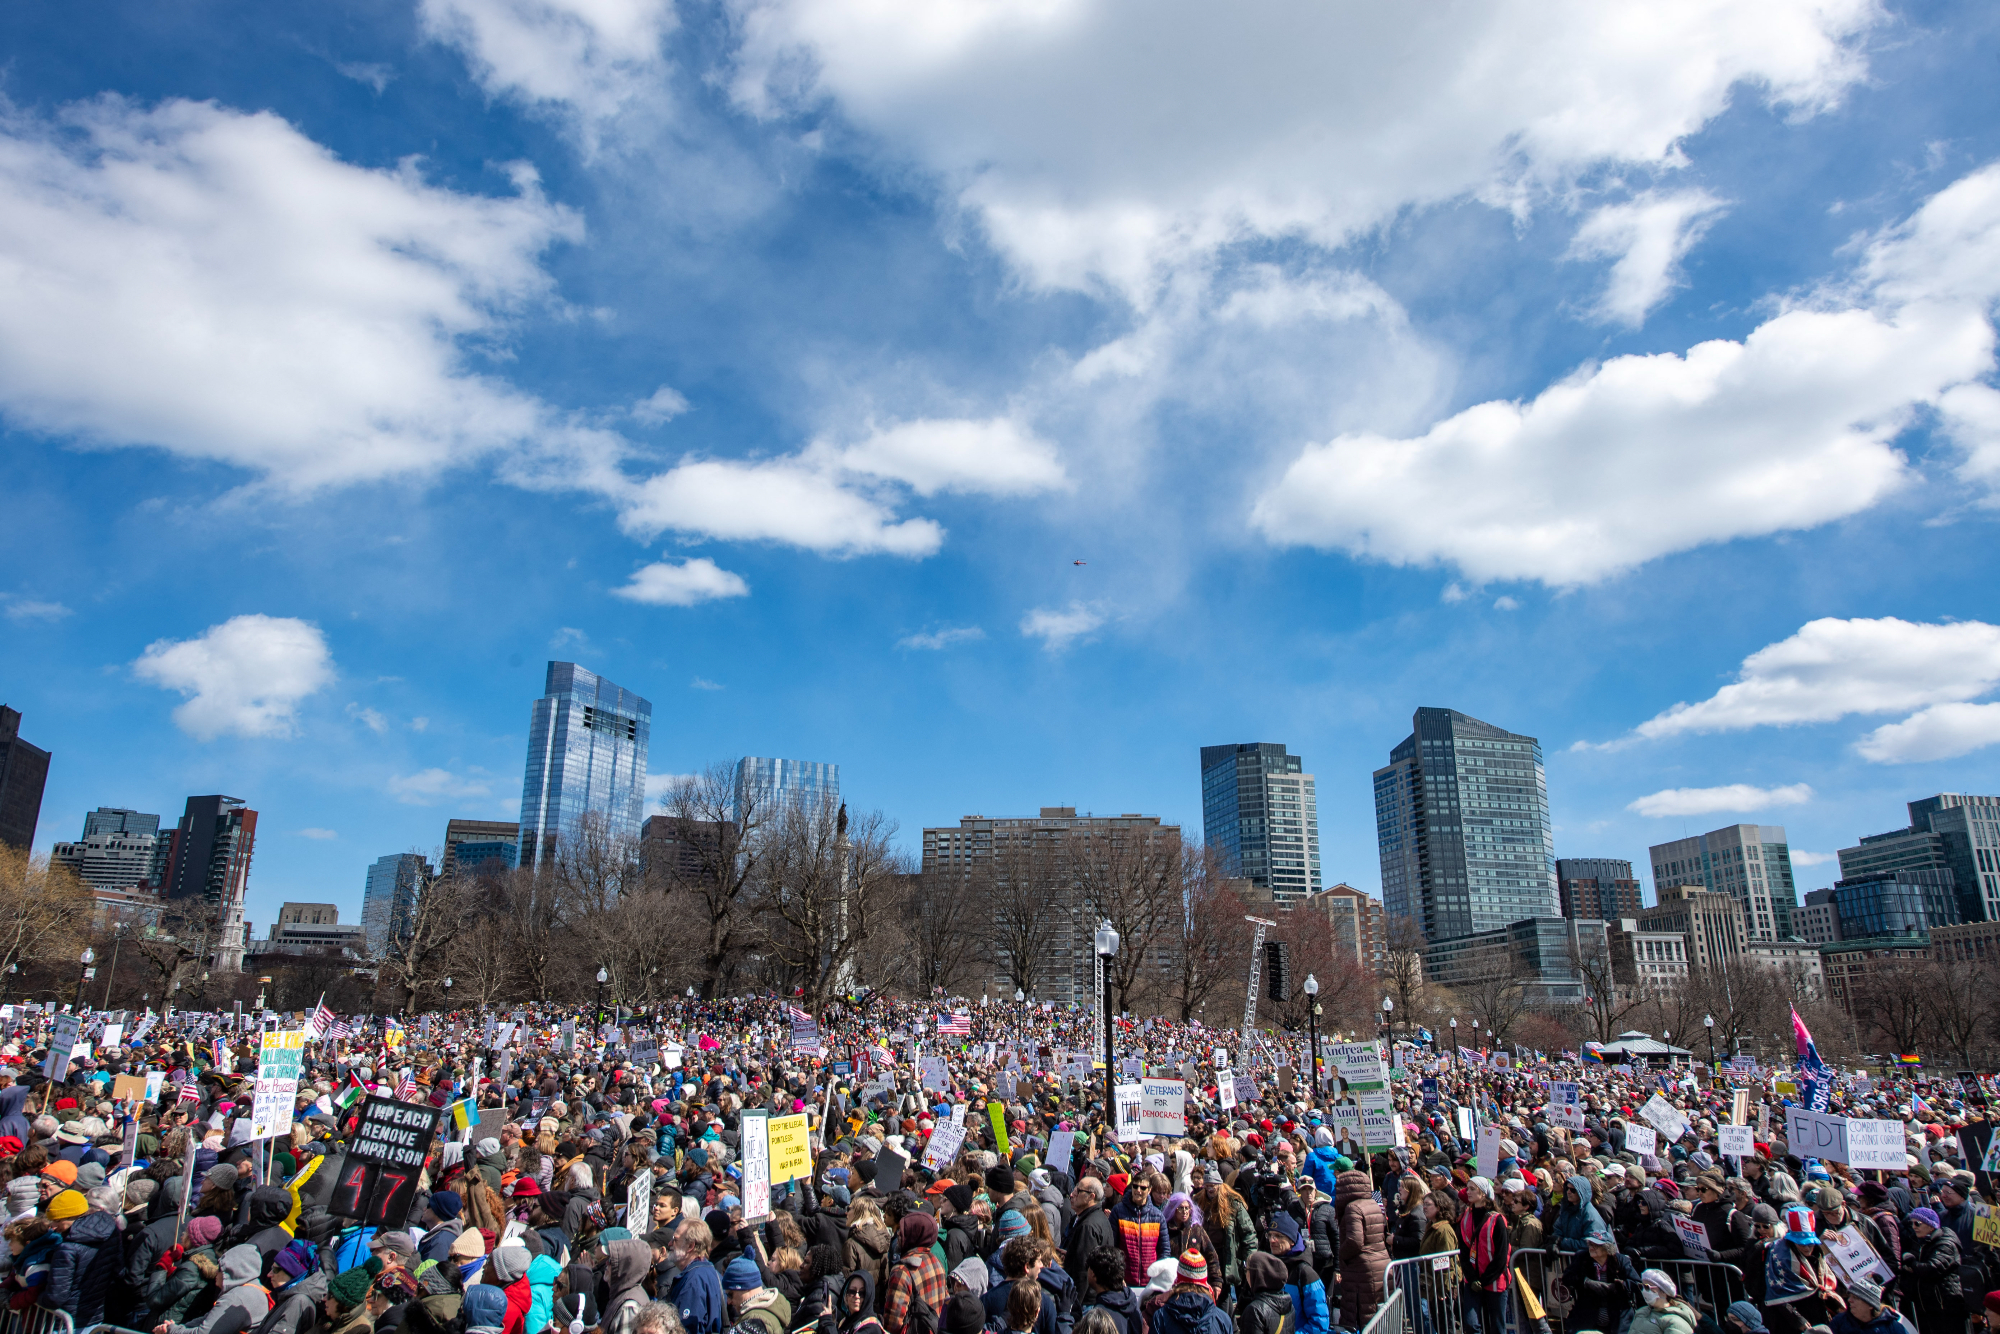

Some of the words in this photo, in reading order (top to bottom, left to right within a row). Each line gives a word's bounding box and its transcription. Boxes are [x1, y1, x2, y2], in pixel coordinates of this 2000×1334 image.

[264, 1032, 281, 1048] BEE
[1325, 1046, 1363, 1056] Andrea
[1346, 1054, 1379, 1064] James
[1340, 1068, 1370, 1076] November
[257, 1080, 270, 1093] Due
[1144, 1084, 1183, 1096] VETERANS
[1154, 1098, 1168, 1106] FOR
[366, 1102, 432, 1130] IMPEACH
[1142, 1109, 1183, 1120] DEMOCRACY
[770, 1124, 781, 1132] STOP
[789, 1120, 804, 1128] ILLEGAL
[938, 1118, 952, 1132] FOR
[1356, 1116, 1390, 1126] James
[1554, 1118, 1579, 1130] AMERICA
[361, 1121, 418, 1147] REMOVE
[750, 1119, 760, 1138] IF
[1630, 1125, 1638, 1133] NO
[1640, 1128, 1654, 1138] ICE
[1795, 1116, 1846, 1152] FDT
[1848, 1122, 1878, 1132] COMBAT
[1882, 1122, 1902, 1134] VETS
[772, 1134, 794, 1144] POINTLESS
[1628, 1134, 1638, 1145] NO
[1639, 1138, 1654, 1150] WAR
[1850, 1134, 1878, 1146] AGAINST
[1880, 1134, 1905, 1146] CORRUPT
[351, 1138, 424, 1166] IMPRISON
[1724, 1142, 1744, 1152] REICH
[793, 1158, 804, 1166] IRAN
[1850, 1150, 1878, 1162] ORANGE
[1880, 1152, 1906, 1163] COWARDS
[1674, 1218, 1704, 1235] ICE
[1984, 1219, 1998, 1233] NO
[1682, 1229, 1700, 1242] OUT
[1848, 1250, 1860, 1260] NO
[1850, 1256, 1874, 1274] KINGS!
